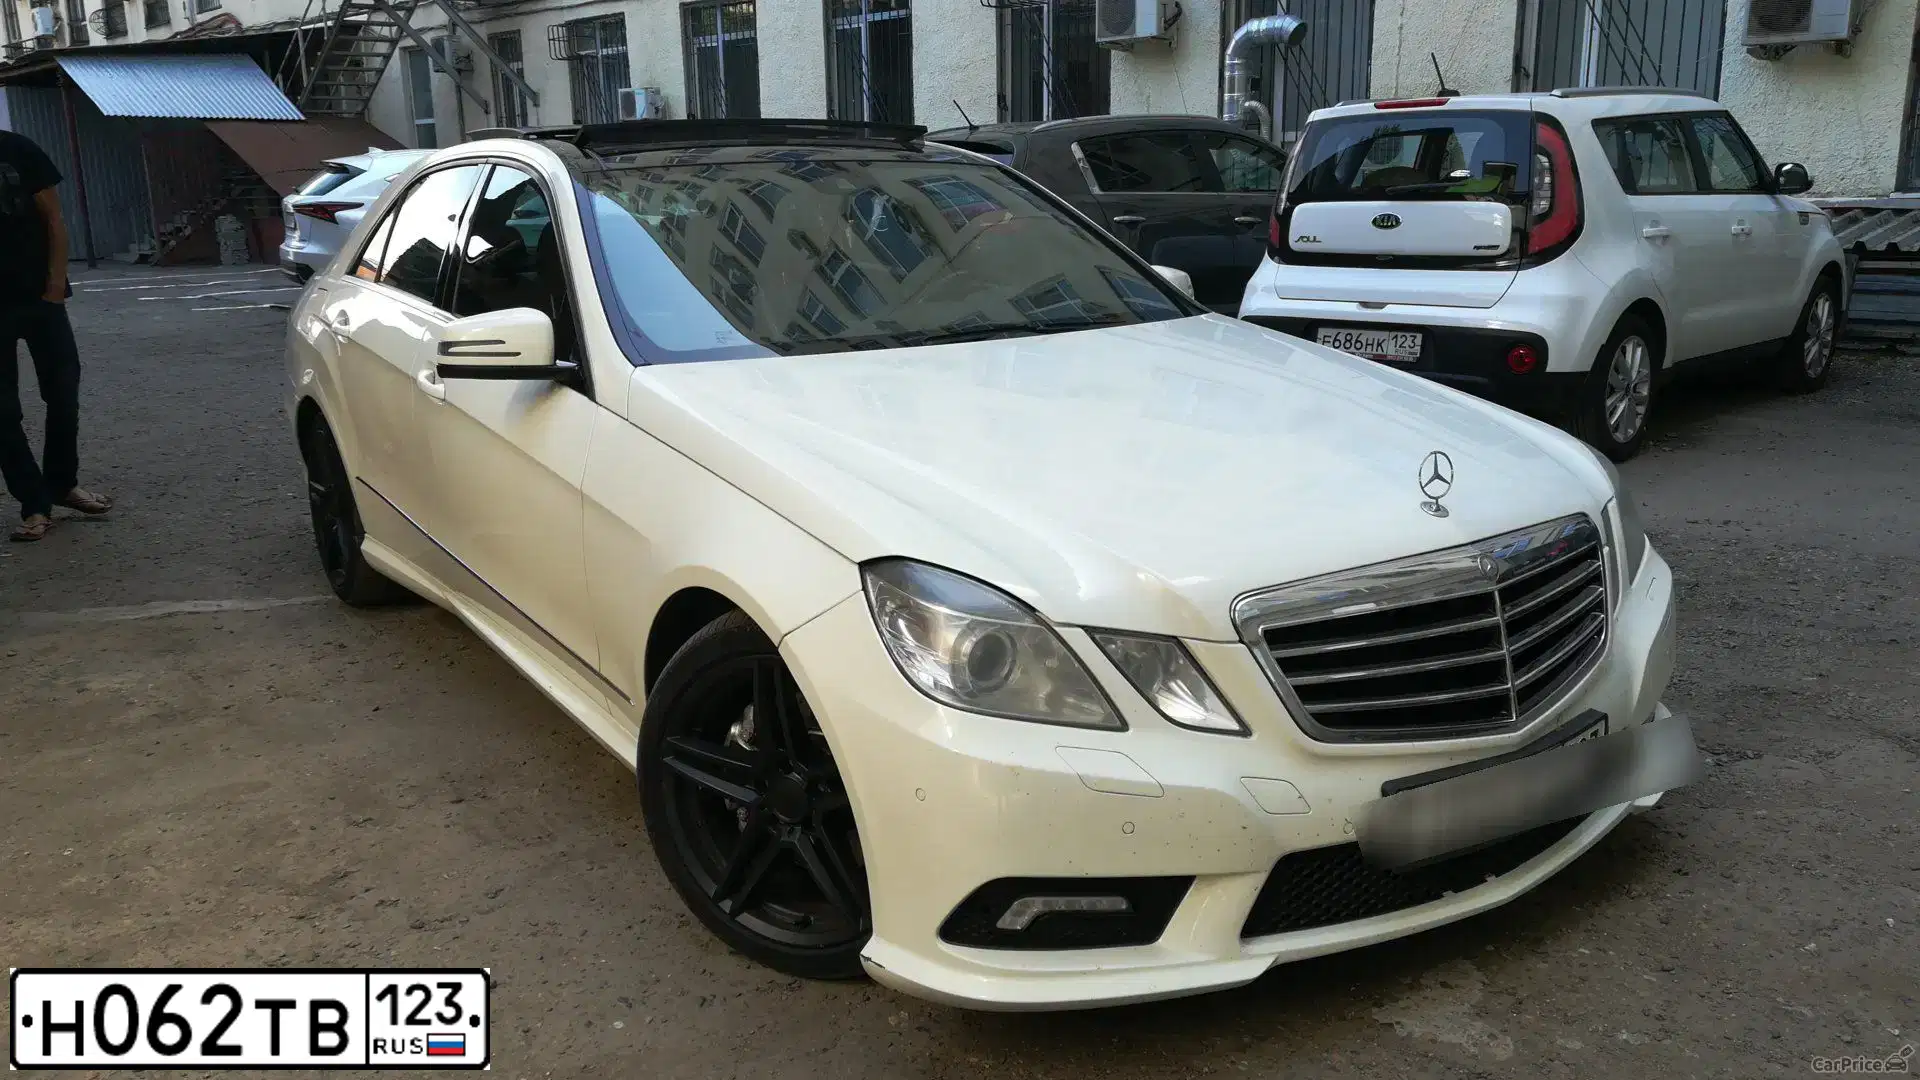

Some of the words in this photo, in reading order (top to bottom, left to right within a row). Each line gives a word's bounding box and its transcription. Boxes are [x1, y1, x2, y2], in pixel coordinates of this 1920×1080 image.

[1376, 214, 1397, 226] KIA
[1294, 235, 1322, 243] SOUL
[1391, 334, 1418, 349] 123
